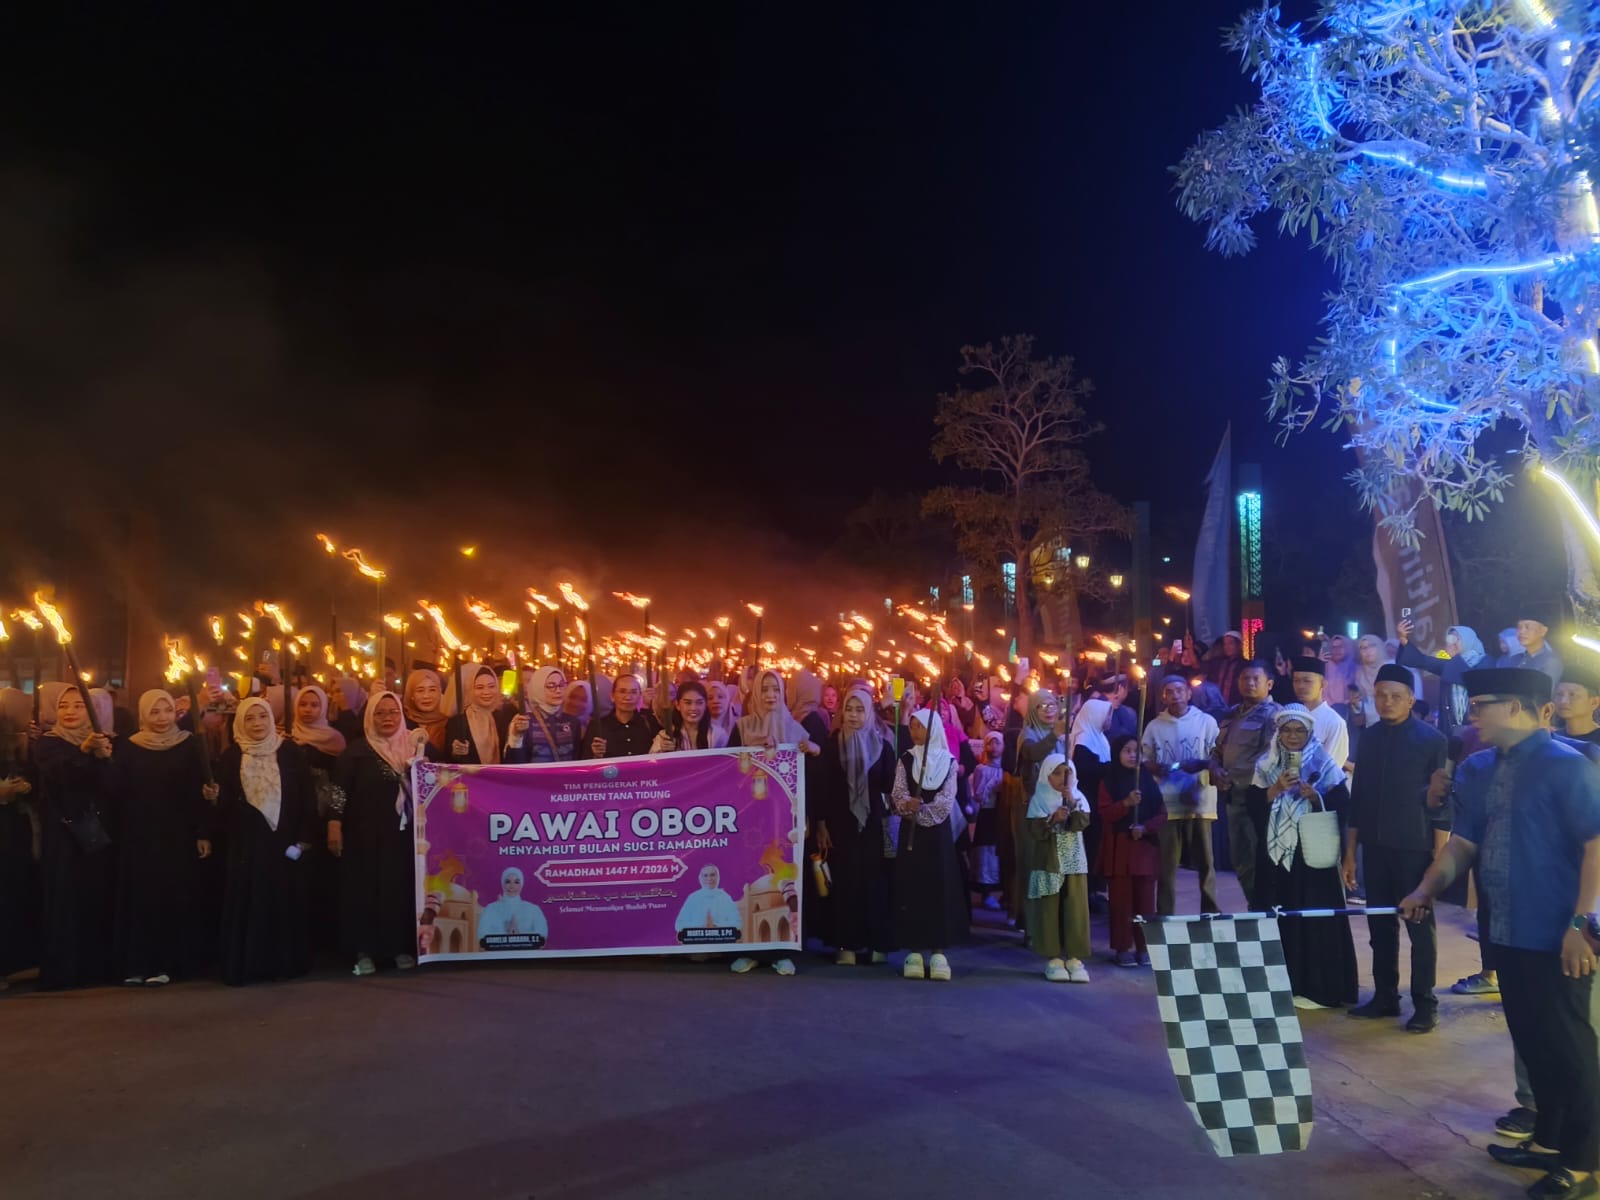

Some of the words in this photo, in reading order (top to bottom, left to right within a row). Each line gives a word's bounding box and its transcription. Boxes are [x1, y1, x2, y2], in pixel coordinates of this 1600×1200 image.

[583, 781, 638, 790] PENGGERAK
[640, 779, 658, 788] PKK
[550, 793, 606, 802] KABUPATEN
[608, 791, 634, 801] TANA
[635, 790, 671, 800] TIDUNG
[489, 810, 619, 841] PAWAI
[631, 805, 738, 837] OBOR
[499, 844, 576, 856] MENYAMBUT
[579, 842, 621, 854] BULAN
[623, 841, 655, 852] SUCI
[658, 838, 728, 850] RAMADHAN
[544, 868, 603, 878] RAMADHAN
[605, 866, 628, 876] 1447
[630, 866, 638, 874] H
[639, 865, 669, 875] /2026
[671, 865, 679, 873] M
